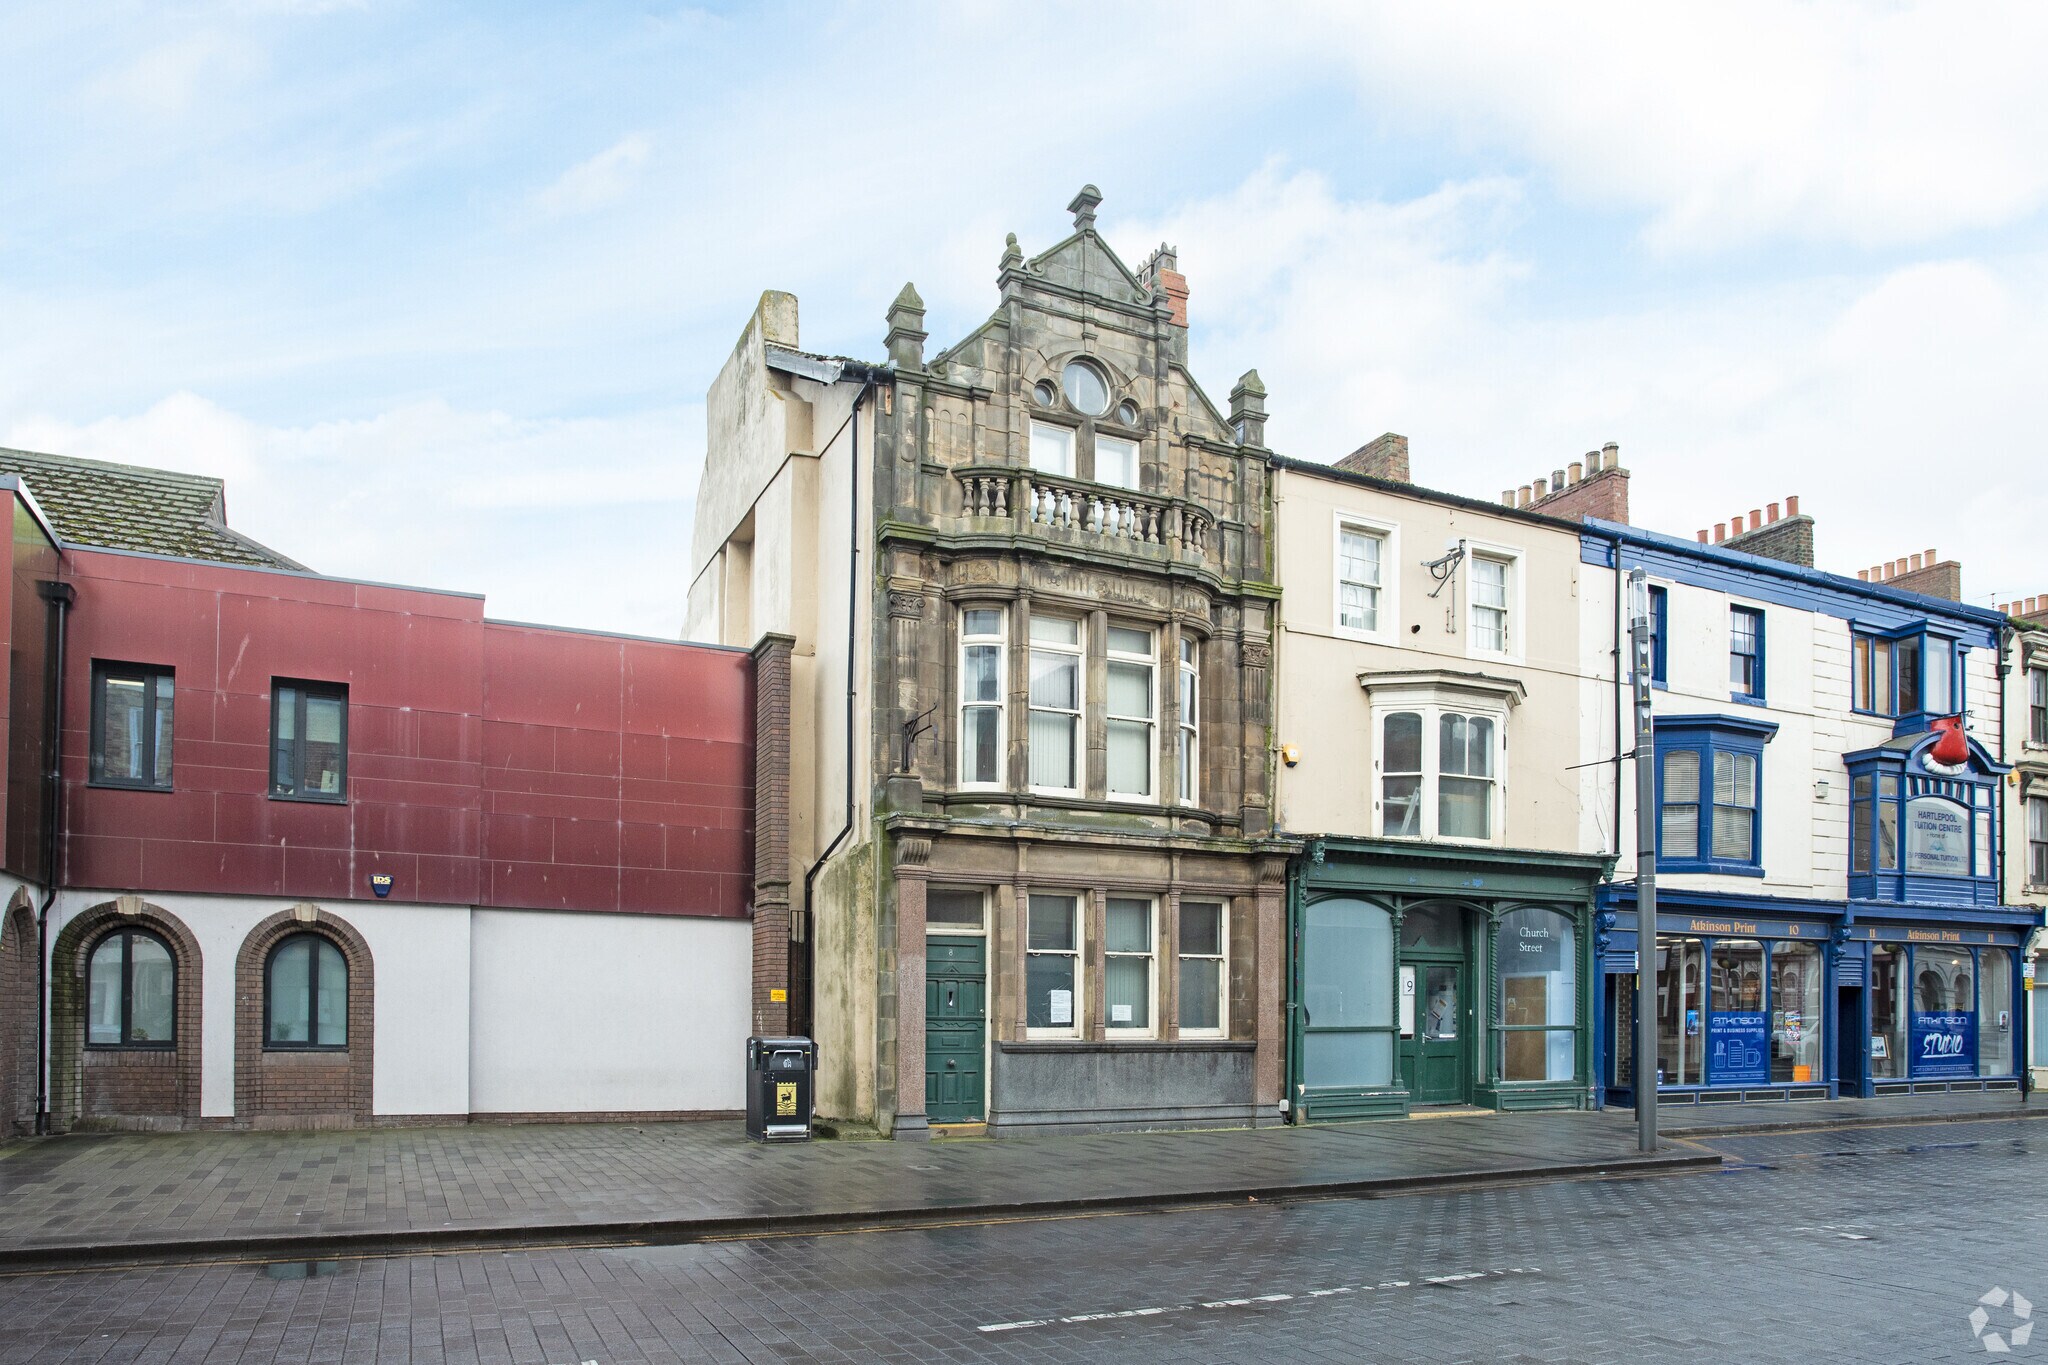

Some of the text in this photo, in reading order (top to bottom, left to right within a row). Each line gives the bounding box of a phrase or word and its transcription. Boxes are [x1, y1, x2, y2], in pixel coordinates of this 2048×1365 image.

[1918, 811, 1957, 822] HARTLEPOOL
[1914, 821, 1962, 833] TUITION CENTRE
[1914, 852, 1940, 861] PERSONAL
[1519, 926, 1549, 938] Church
[1690, 919, 1799, 935] Atkinson Print 10
[1869, 928, 1994, 943] 11 Atkinson Print 11
[1519, 941, 1543, 953] Street
[1406, 980, 1414, 992] 9
[1923, 1032, 1963, 1055] STUDIO
